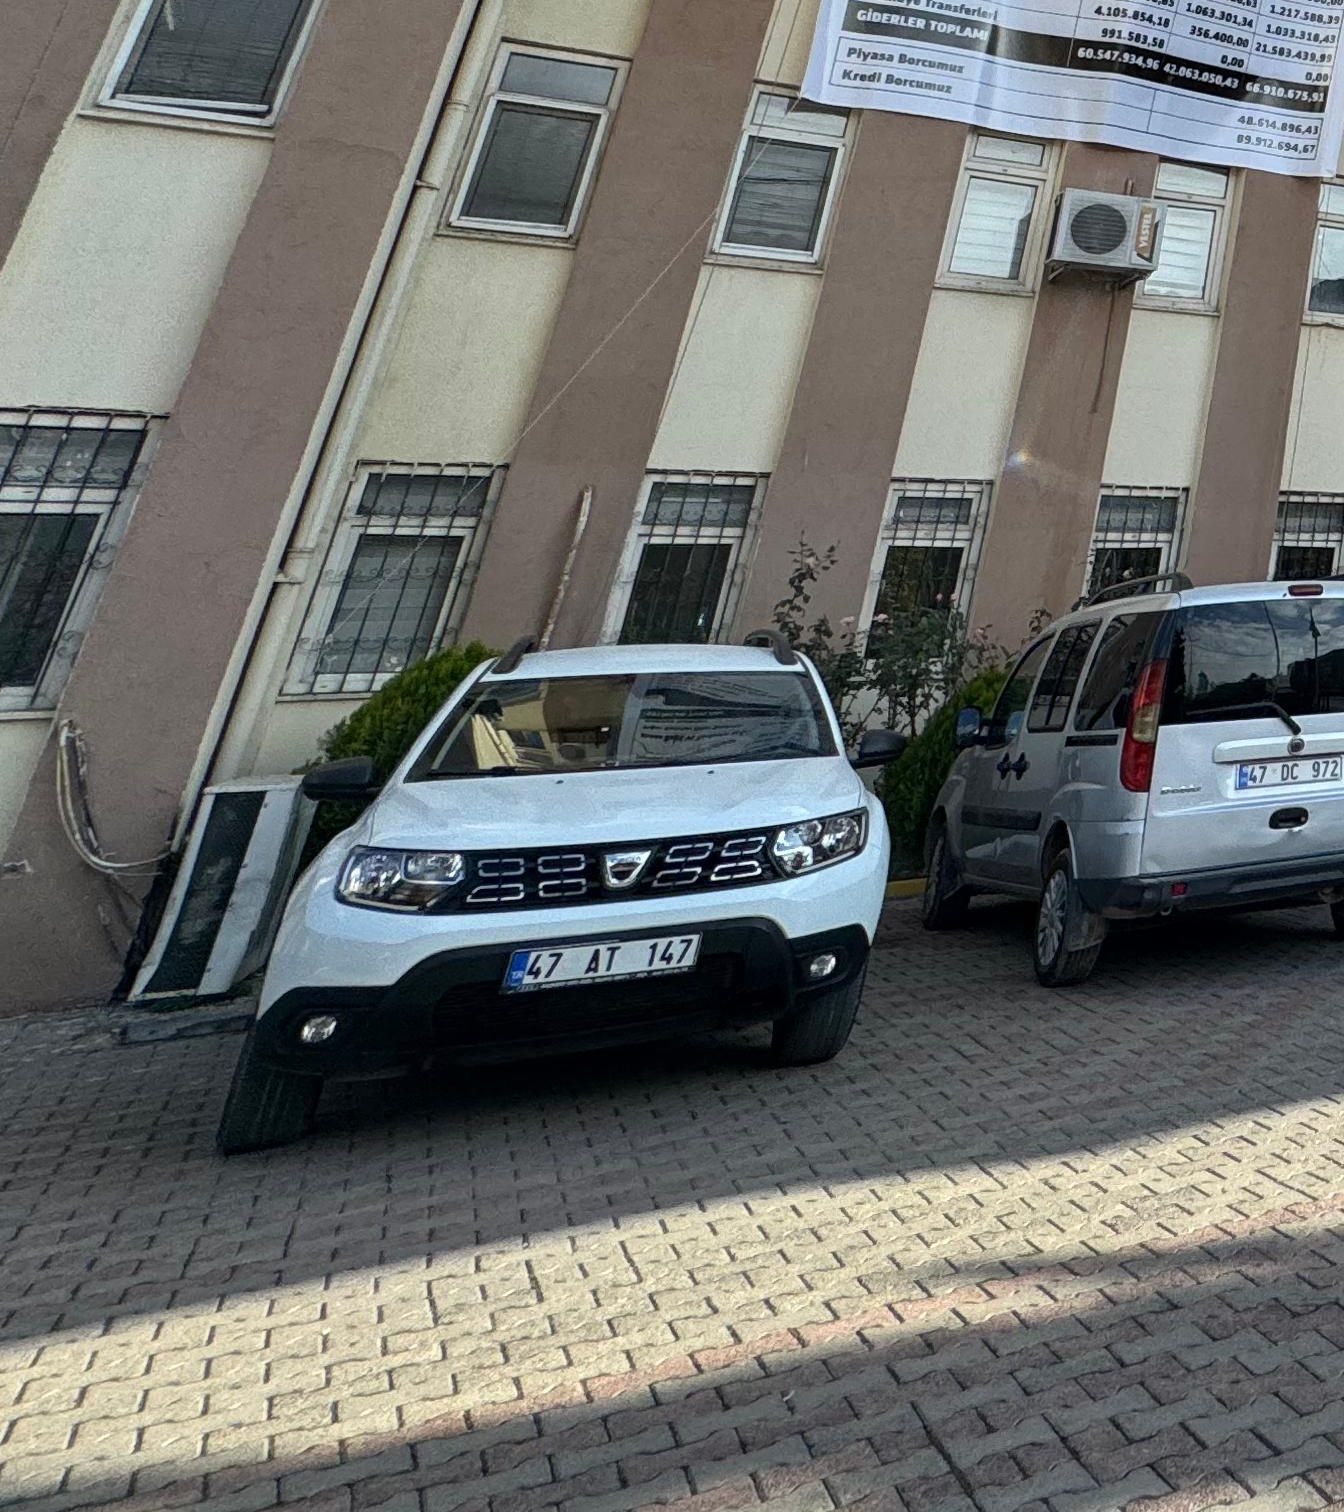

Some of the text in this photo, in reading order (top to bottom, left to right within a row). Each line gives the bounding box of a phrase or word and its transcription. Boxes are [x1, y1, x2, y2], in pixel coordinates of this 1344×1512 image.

[855, 6, 927, 32] GİDERLER
[845, 45, 895, 66] Piyasa
[840, 66, 883, 85] Kredi
[1249, 760, 1339, 784] 47 DC 972
[527, 953, 563, 979] 47
[585, 946, 621, 975] AT
[649, 939, 693, 968] 147
